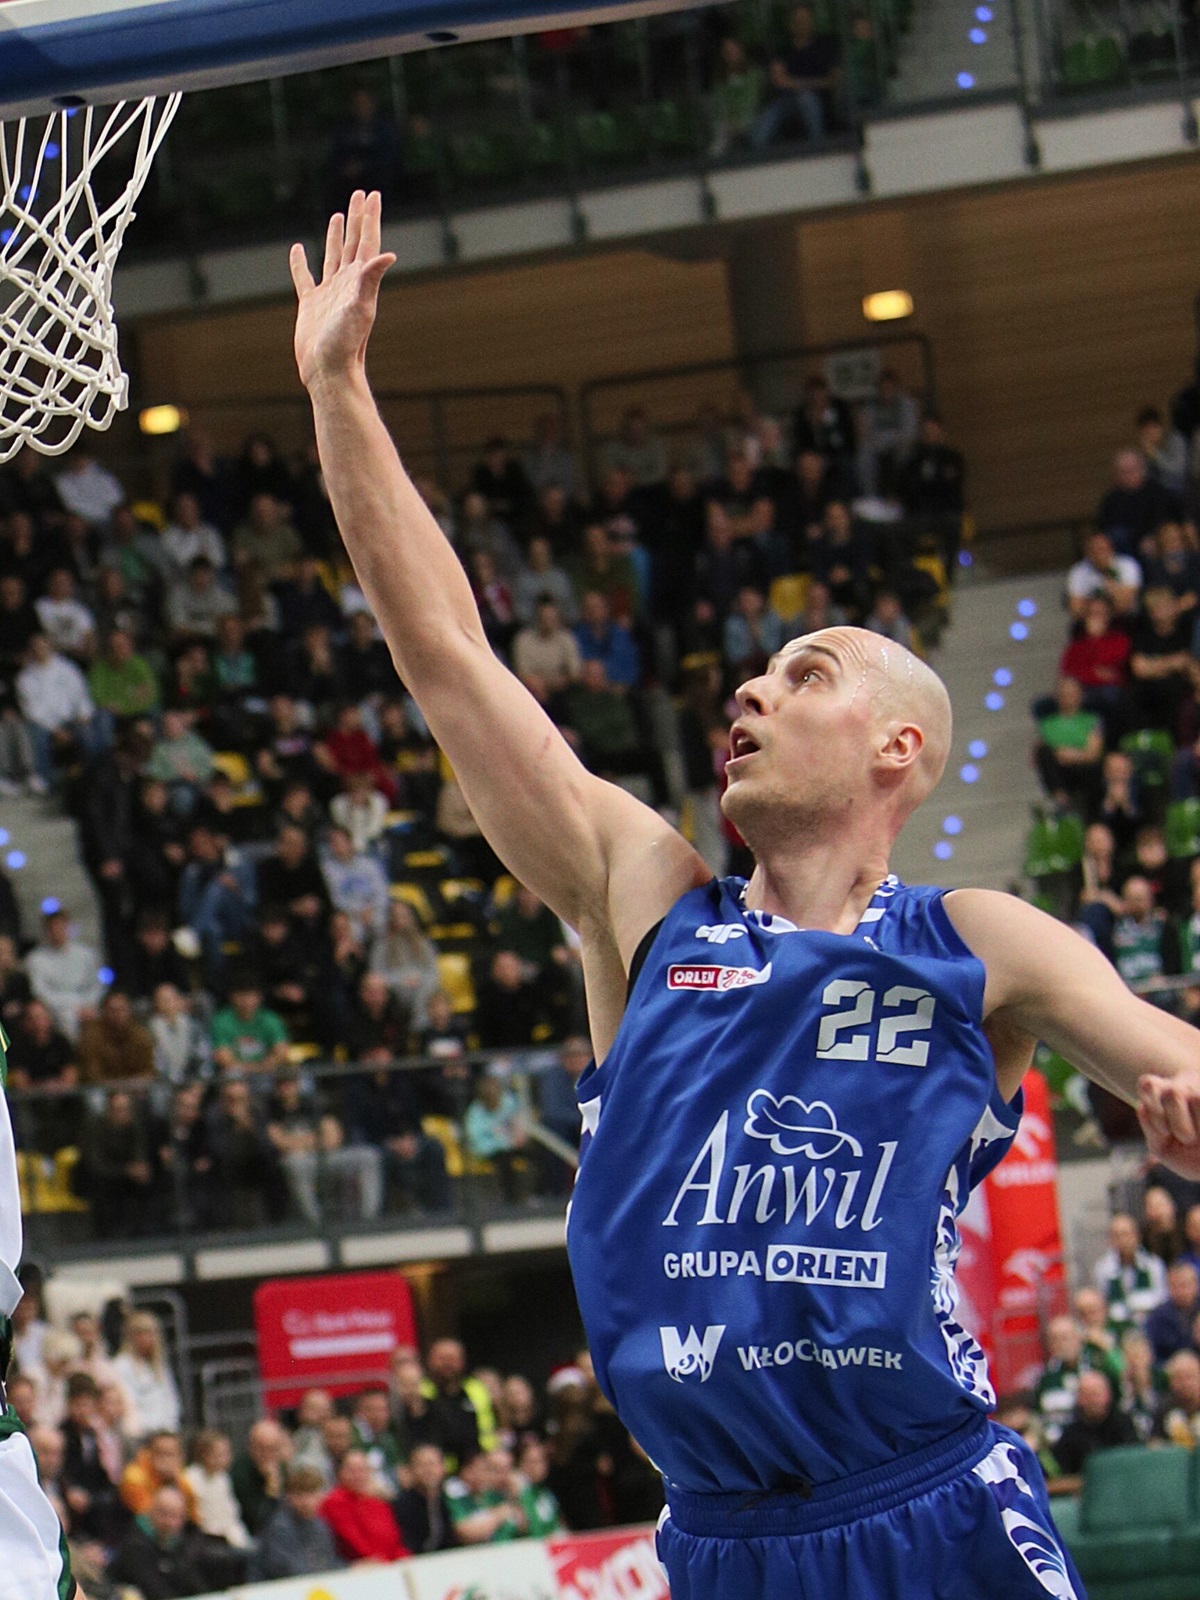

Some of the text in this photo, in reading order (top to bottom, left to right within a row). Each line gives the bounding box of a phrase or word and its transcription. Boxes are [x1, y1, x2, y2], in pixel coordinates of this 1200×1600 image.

[673, 970, 716, 985] ORLEN
[816, 979, 937, 1068] 22
[661, 1109, 898, 1232] Anwil
[663, 1250, 878, 1282] GRUPA ORLEN
